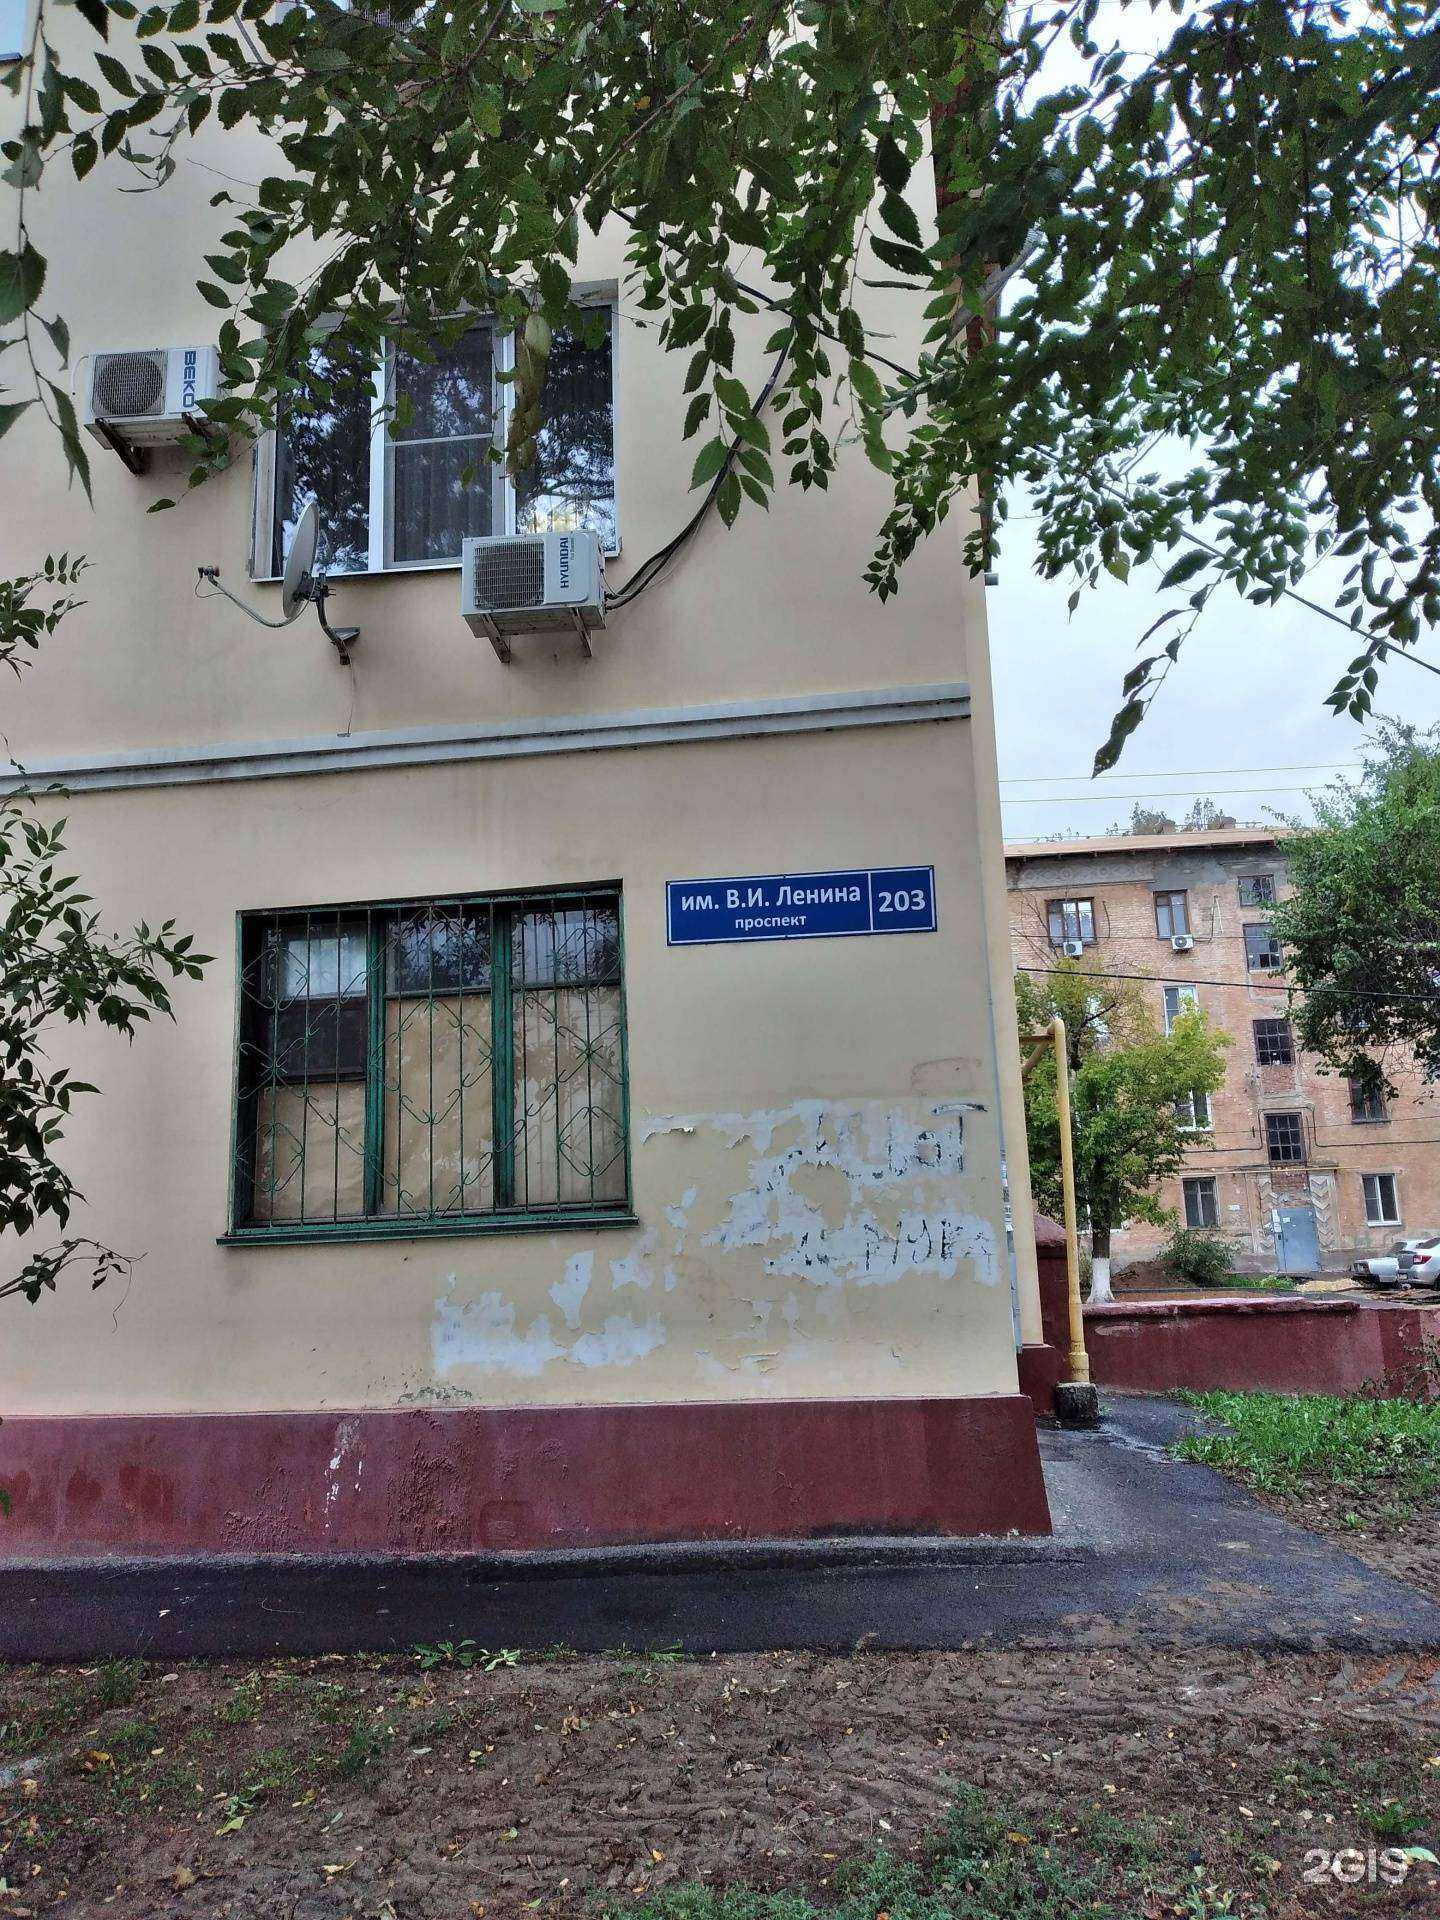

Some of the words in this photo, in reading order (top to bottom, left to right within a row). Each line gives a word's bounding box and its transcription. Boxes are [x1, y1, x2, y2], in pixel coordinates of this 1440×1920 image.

[183, 351, 196, 408] BEKO
[560, 537, 569, 589] HYUNDAI
[681, 894, 720, 911] им.
[726, 887, 770, 909] В.И.
[776, 885, 861, 907] Ленина
[877, 889, 927, 913] 203
[735, 914, 807, 931] проспект
